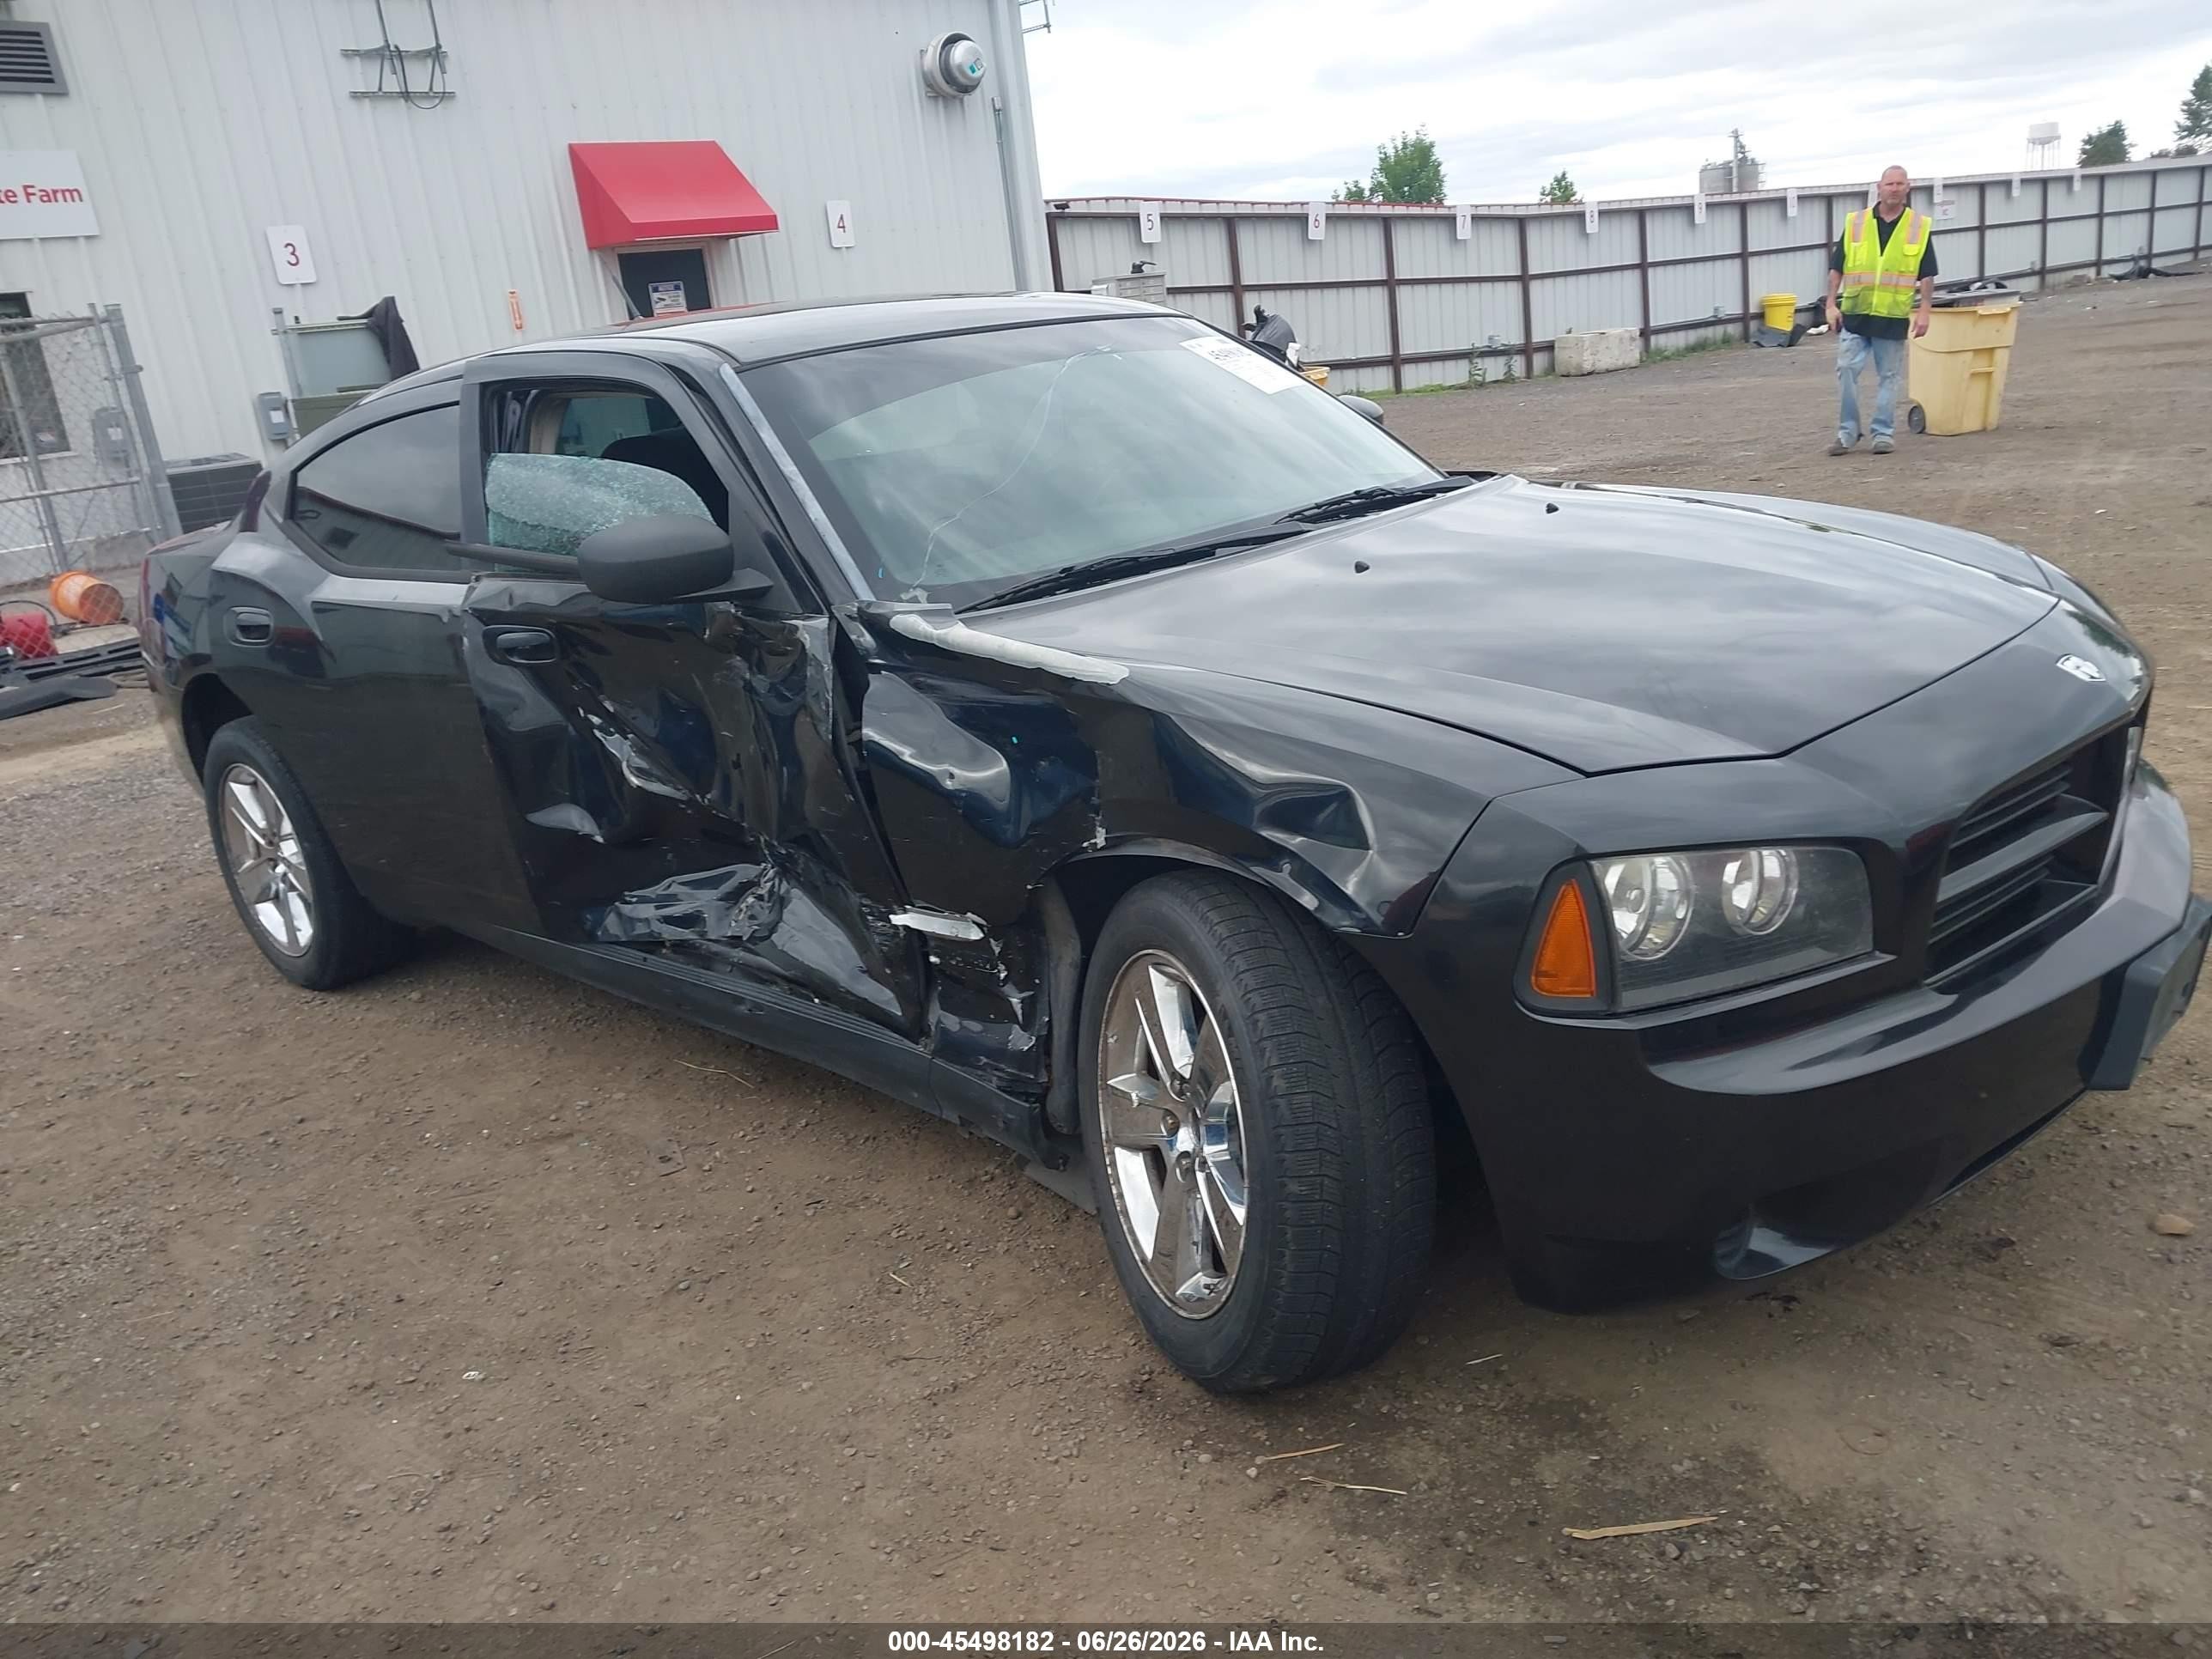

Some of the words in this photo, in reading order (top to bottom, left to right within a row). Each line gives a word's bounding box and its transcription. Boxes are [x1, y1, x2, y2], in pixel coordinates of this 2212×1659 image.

[21, 185, 83, 204] Farm
[837, 214, 846, 233] 4
[1146, 213, 1154, 231] 5
[1314, 213, 1320, 228] 6
[1461, 215, 1467, 229] 7
[283, 242, 300, 267] 3
